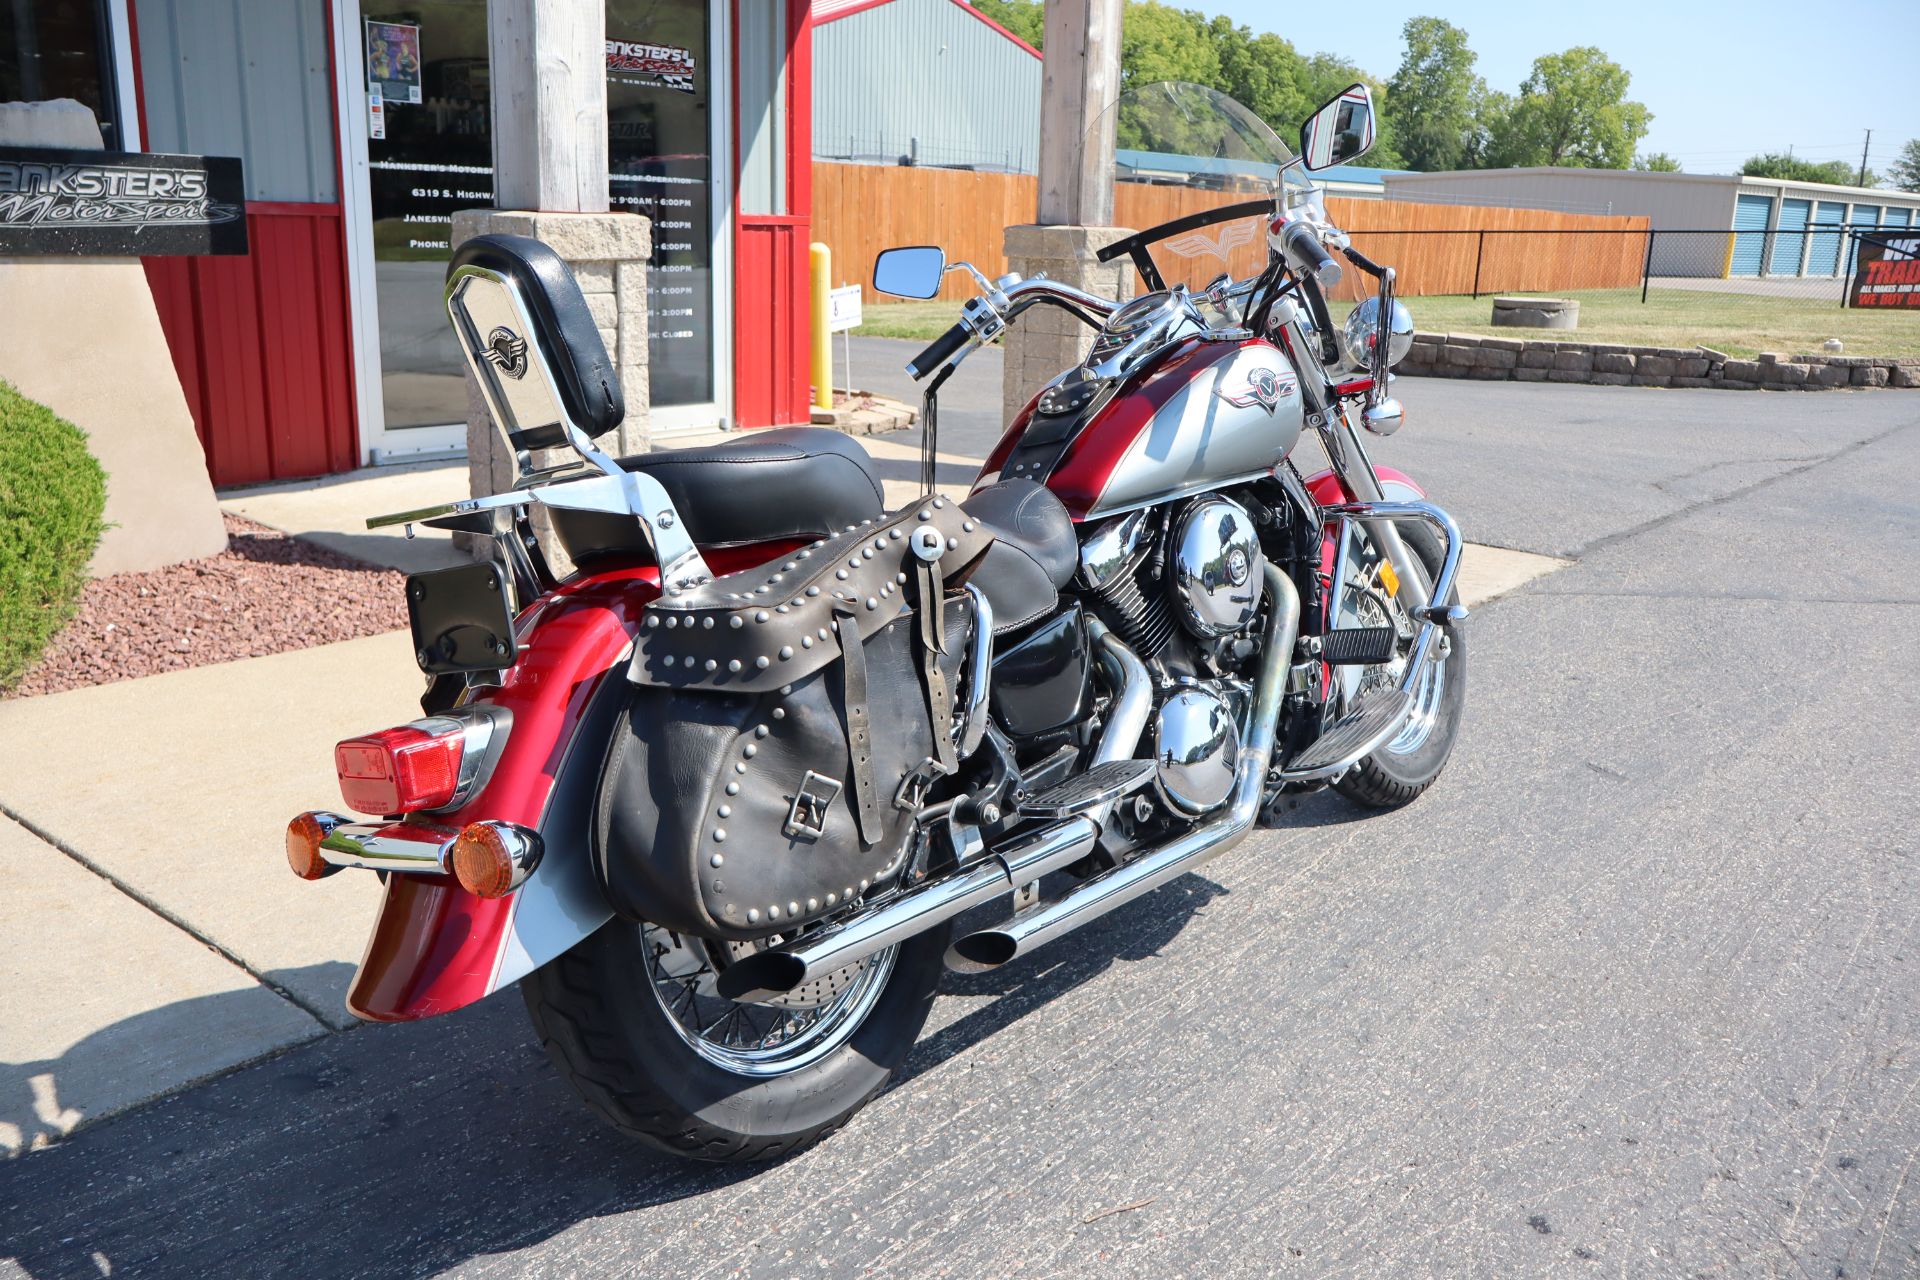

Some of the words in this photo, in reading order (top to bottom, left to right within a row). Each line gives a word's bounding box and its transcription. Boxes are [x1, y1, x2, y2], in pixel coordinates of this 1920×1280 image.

[622, 78, 661, 88] SERVICE
[380, 160, 446, 172] HANKSTER'S
[646, 174, 692, 184] OPERATION
[411, 188, 440, 197] 6319
[442, 189, 454, 198] S.
[660, 198, 692, 206] 6:00PM
[660, 220, 692, 229] 6:00PM
[410, 239, 449, 249] PHONE:
[661, 243, 692, 251] 6:00PM
[1883, 239, 1920, 260] WE
[661, 265, 692, 273] 6:00PM
[661, 287, 692, 295] 6:00PM
[1860, 285, 1872, 293] ALL
[1873, 284, 1897, 293] MAKES
[1897, 284, 1913, 293] AND
[1858, 293, 1877, 305] WE
[1880, 293, 1905, 305] BUY
[662, 308, 693, 317] 3:00PM
[662, 330, 694, 338] CLOSED
